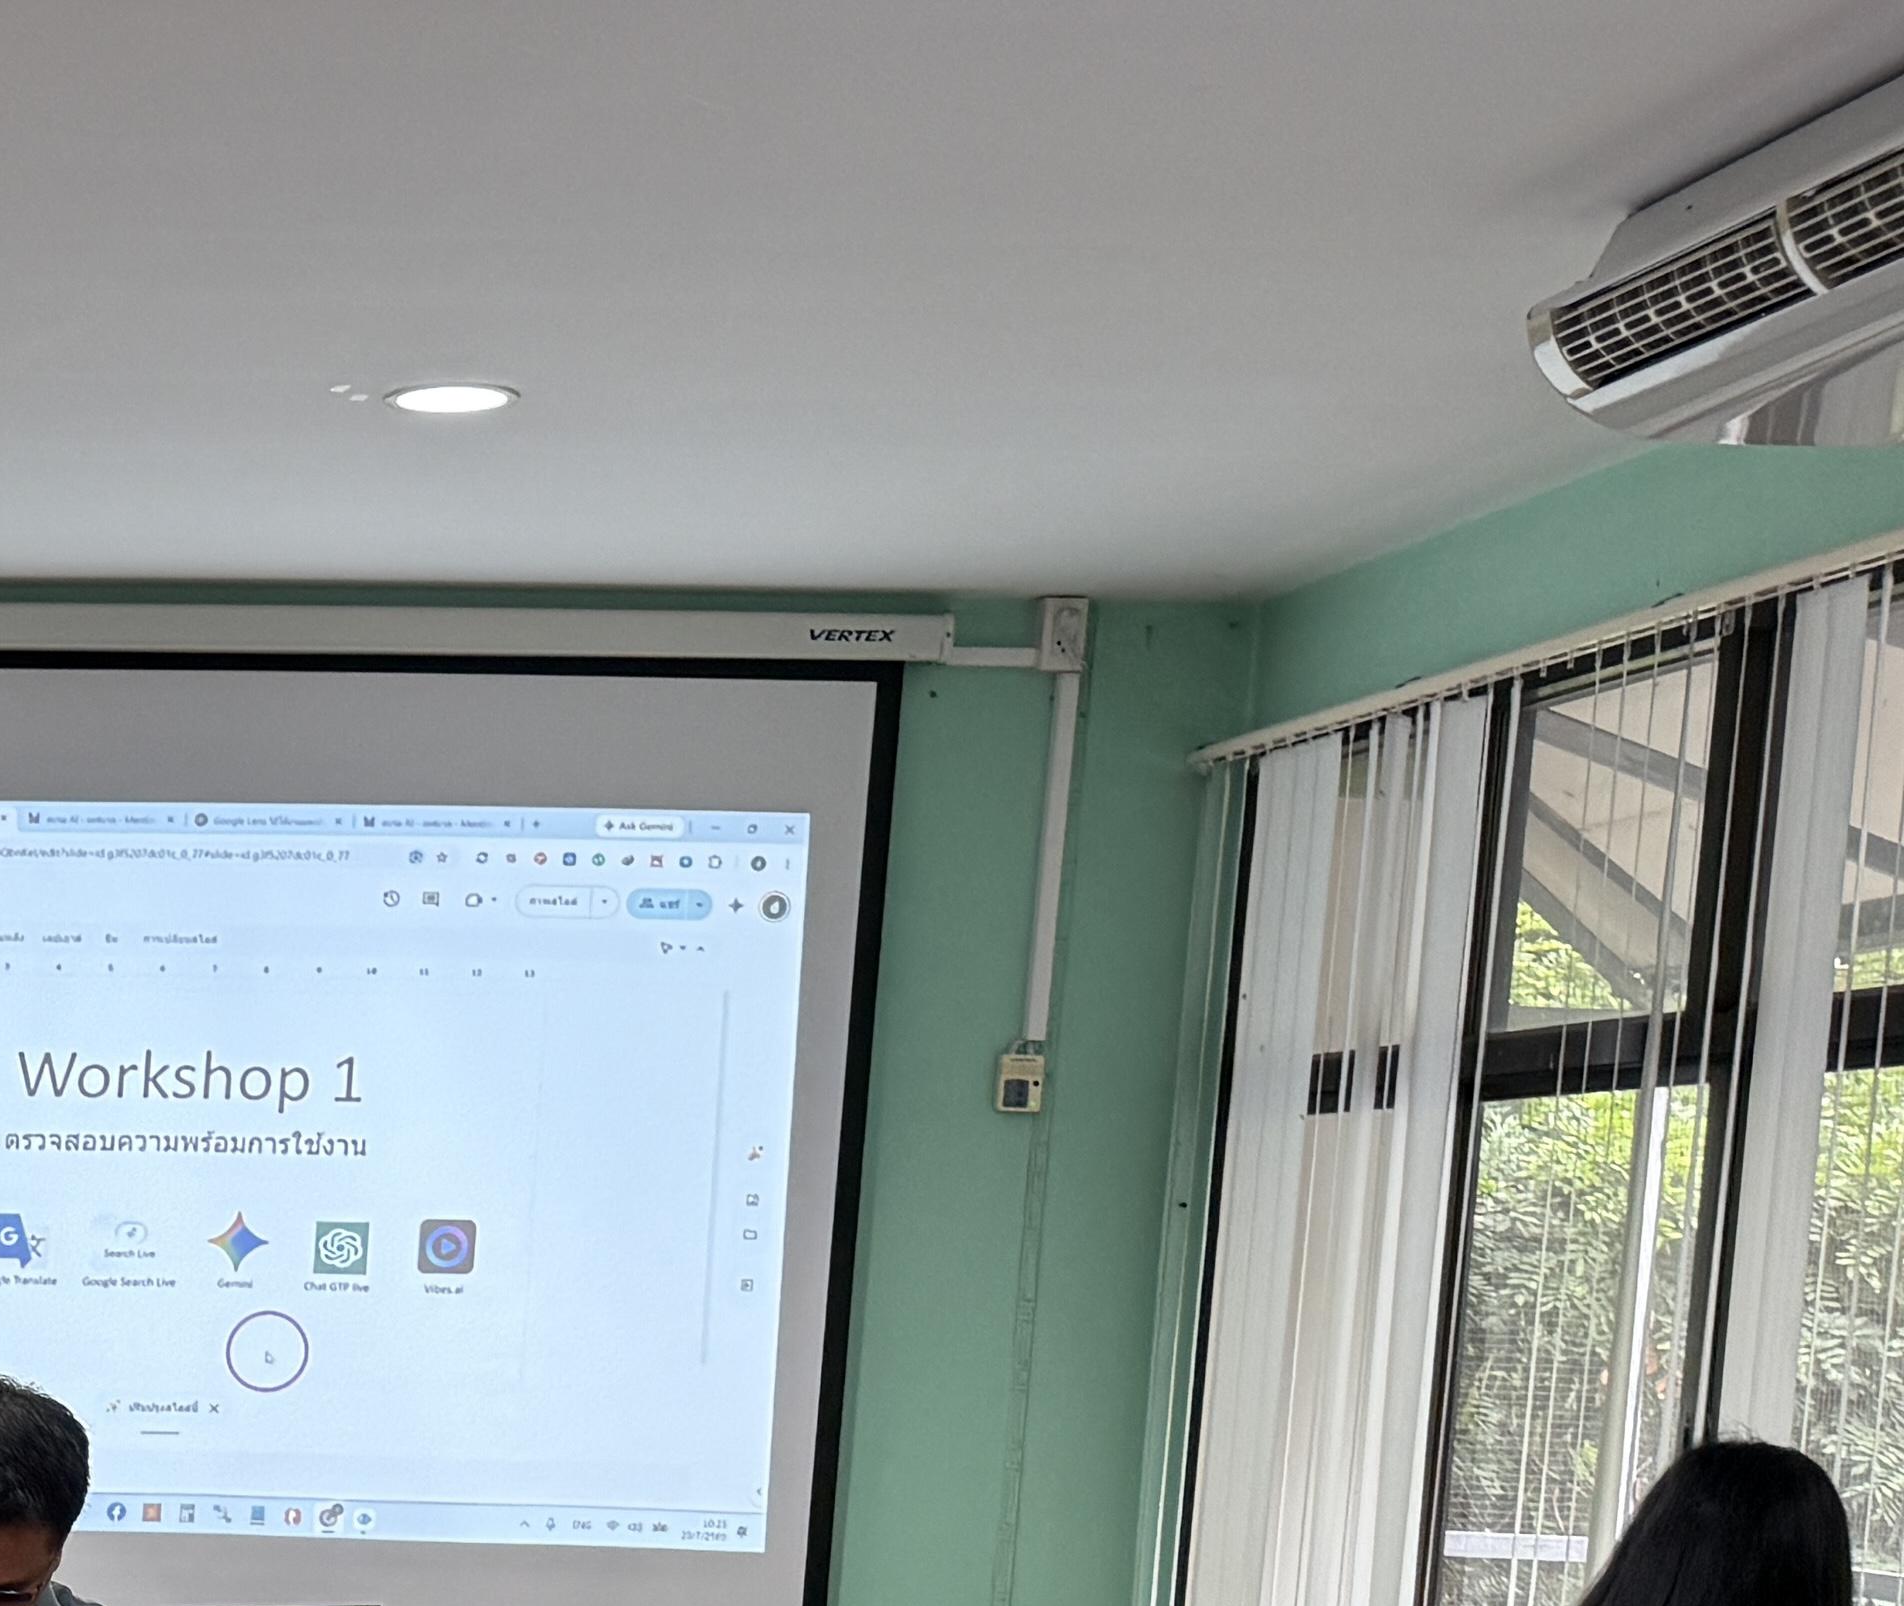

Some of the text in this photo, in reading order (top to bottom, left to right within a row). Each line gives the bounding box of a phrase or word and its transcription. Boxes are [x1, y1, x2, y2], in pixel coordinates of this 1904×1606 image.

[809, 629, 895, 642] VERTEX
[619, 822, 674, 832] Ask Gemini
[18, 1049, 363, 1113] Workshop 1
[4, 1129, 368, 1158] ตรวจสอบความพร้อมการใช้งาน
[104, 1248, 156, 1259] Search Live
[14, 1275, 57, 1286] Translate
[82, 1276, 176, 1288] Google Search Live
[217, 1278, 253, 1289] Gemini
[304, 1281, 370, 1293] Chat GTP live
